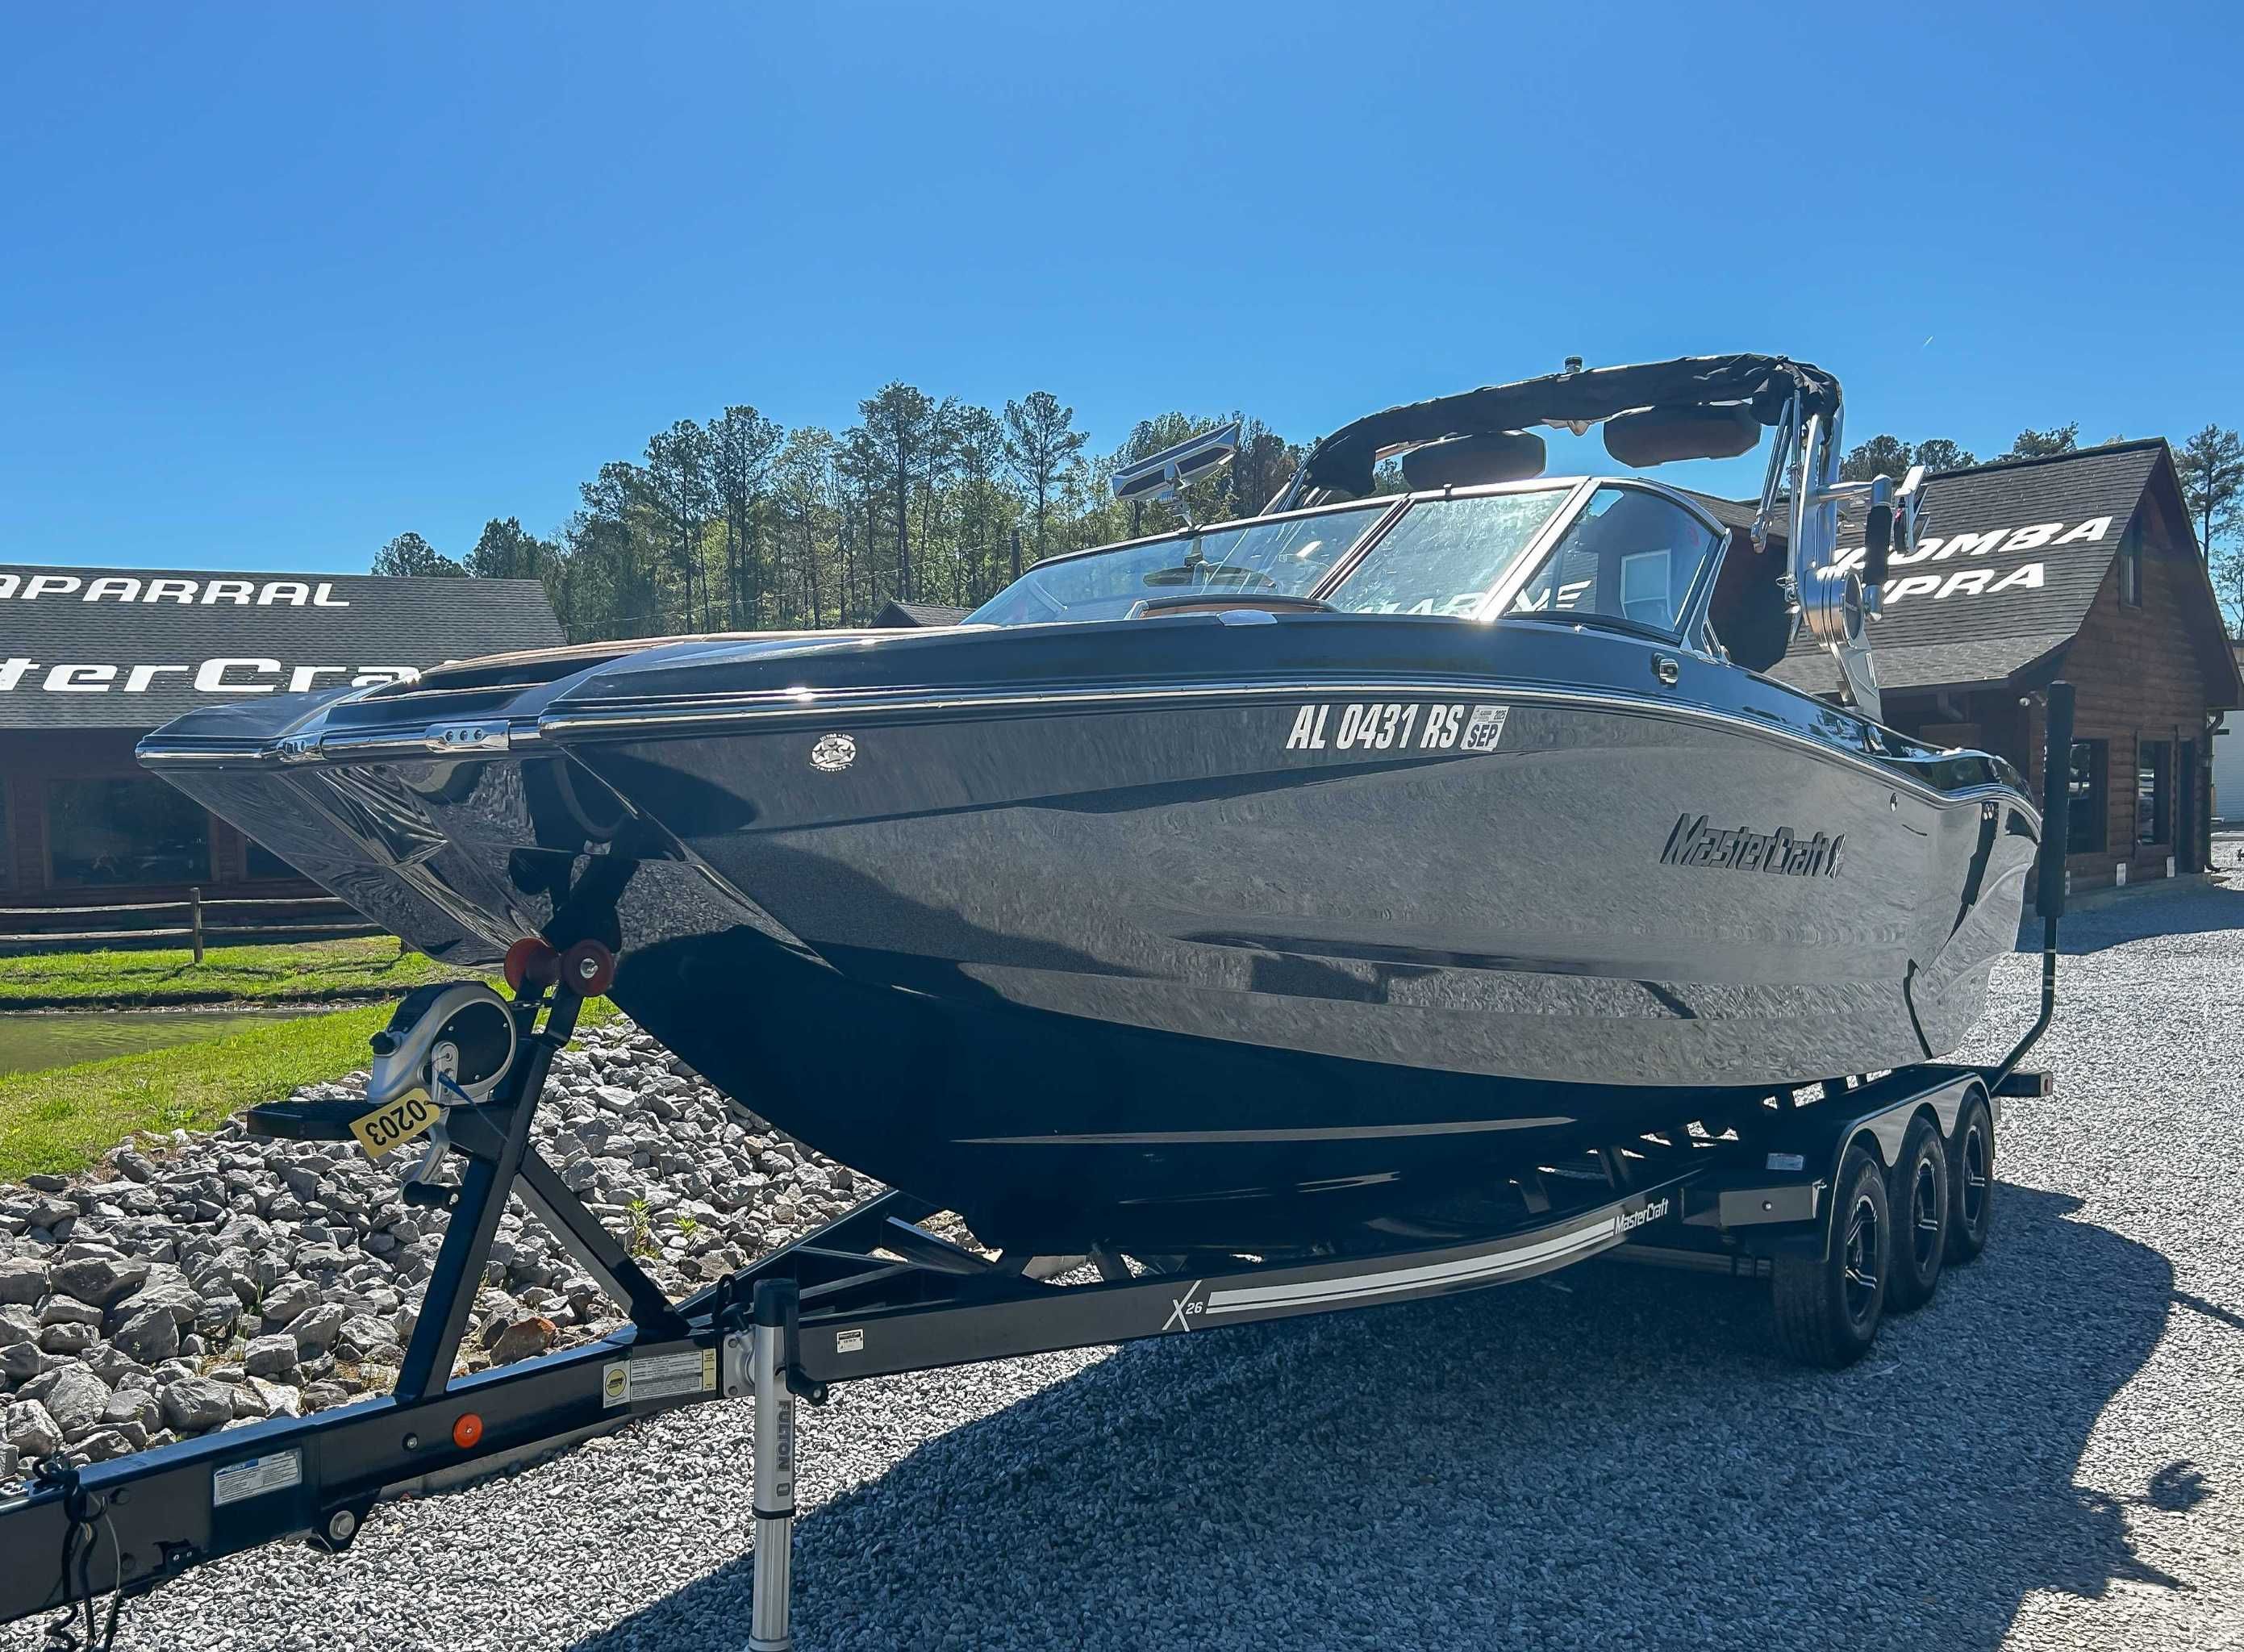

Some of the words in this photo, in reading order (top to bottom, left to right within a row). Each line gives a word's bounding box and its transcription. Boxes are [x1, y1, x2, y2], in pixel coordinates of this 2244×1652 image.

[1833, 516, 2113, 569] OMBA
[1883, 563, 2045, 604] PRA
[1285, 705, 1330, 749] AL
[1336, 704, 1420, 749] 0431
[1420, 704, 1464, 749] RS
[1467, 724, 1499, 748] SEP
[1659, 812, 1831, 877] MasterCraft
[365, 1099, 428, 1146] 0203
[1615, 1198, 1669, 1235] MasterCraft
[776, 1400, 792, 1472] FULTON
